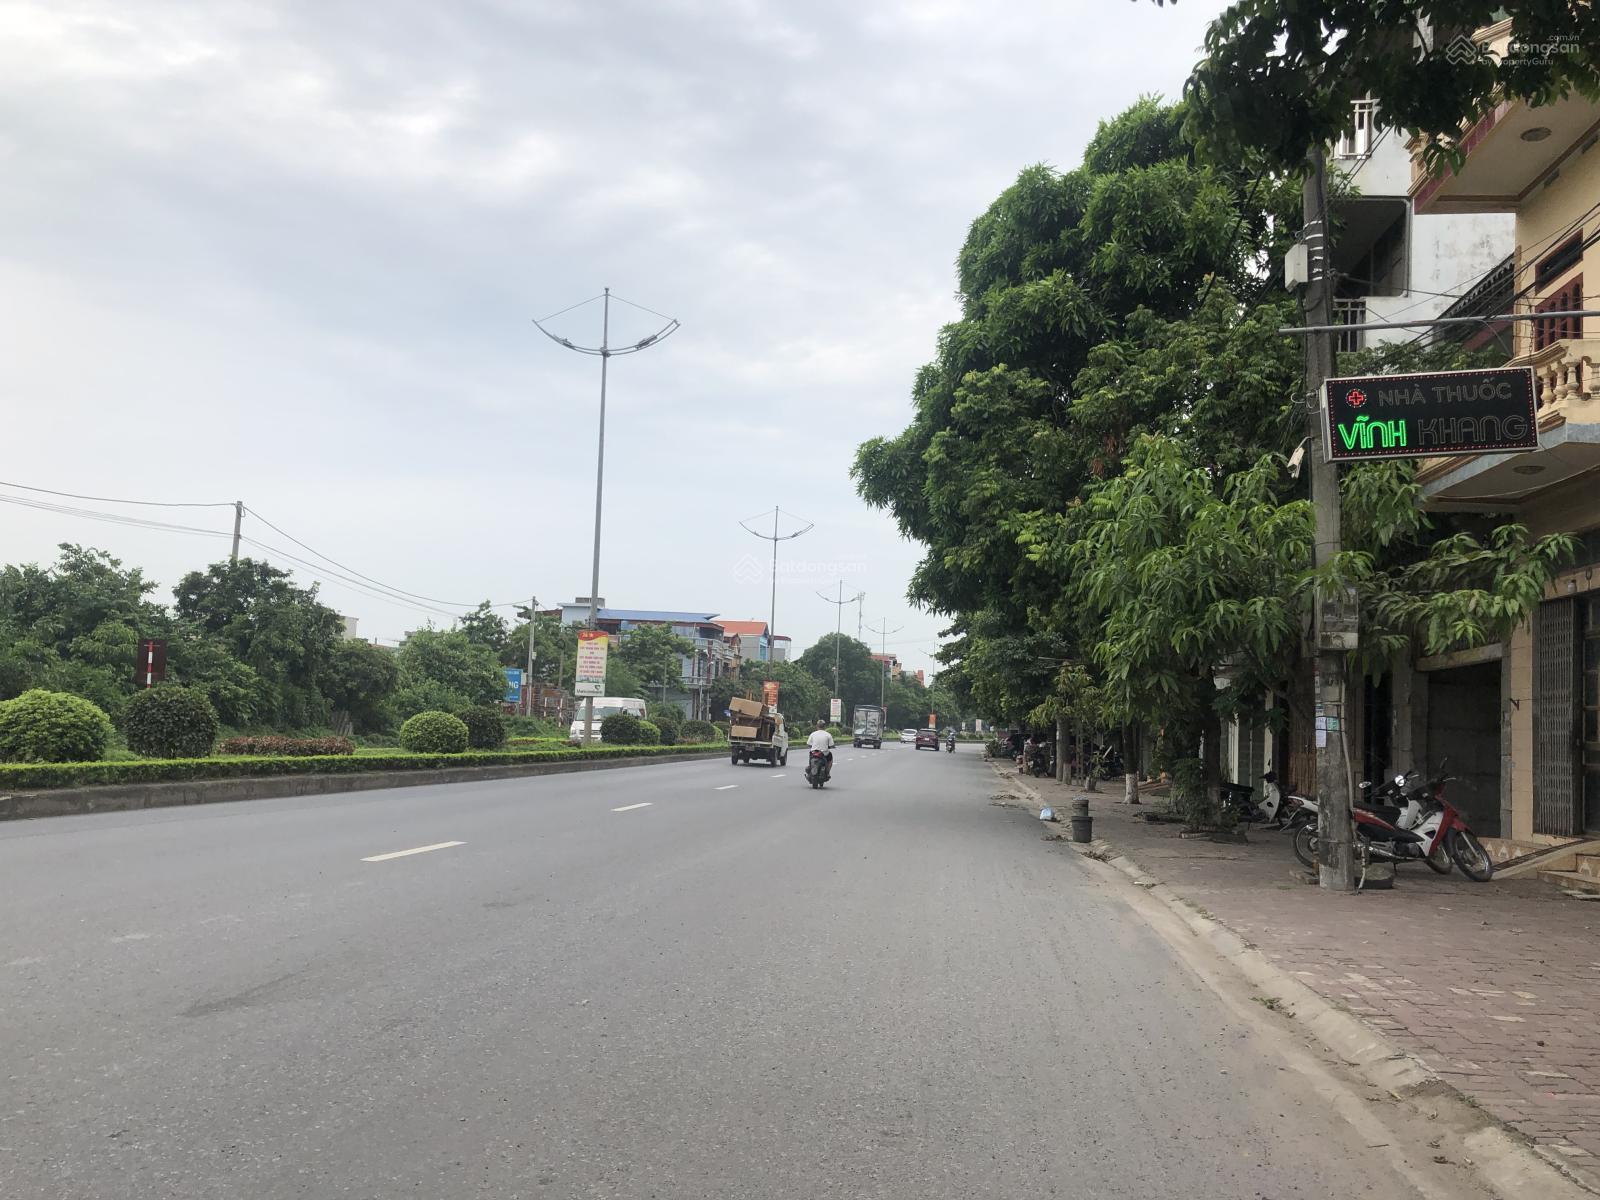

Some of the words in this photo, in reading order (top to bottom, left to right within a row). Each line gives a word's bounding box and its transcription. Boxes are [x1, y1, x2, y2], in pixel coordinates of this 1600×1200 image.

[1378, 384, 1426, 407] NHÀ
[1432, 378, 1512, 403] THUỐC
[1338, 415, 1407, 450] VĨNH
[1417, 414, 1528, 446] KHANG
